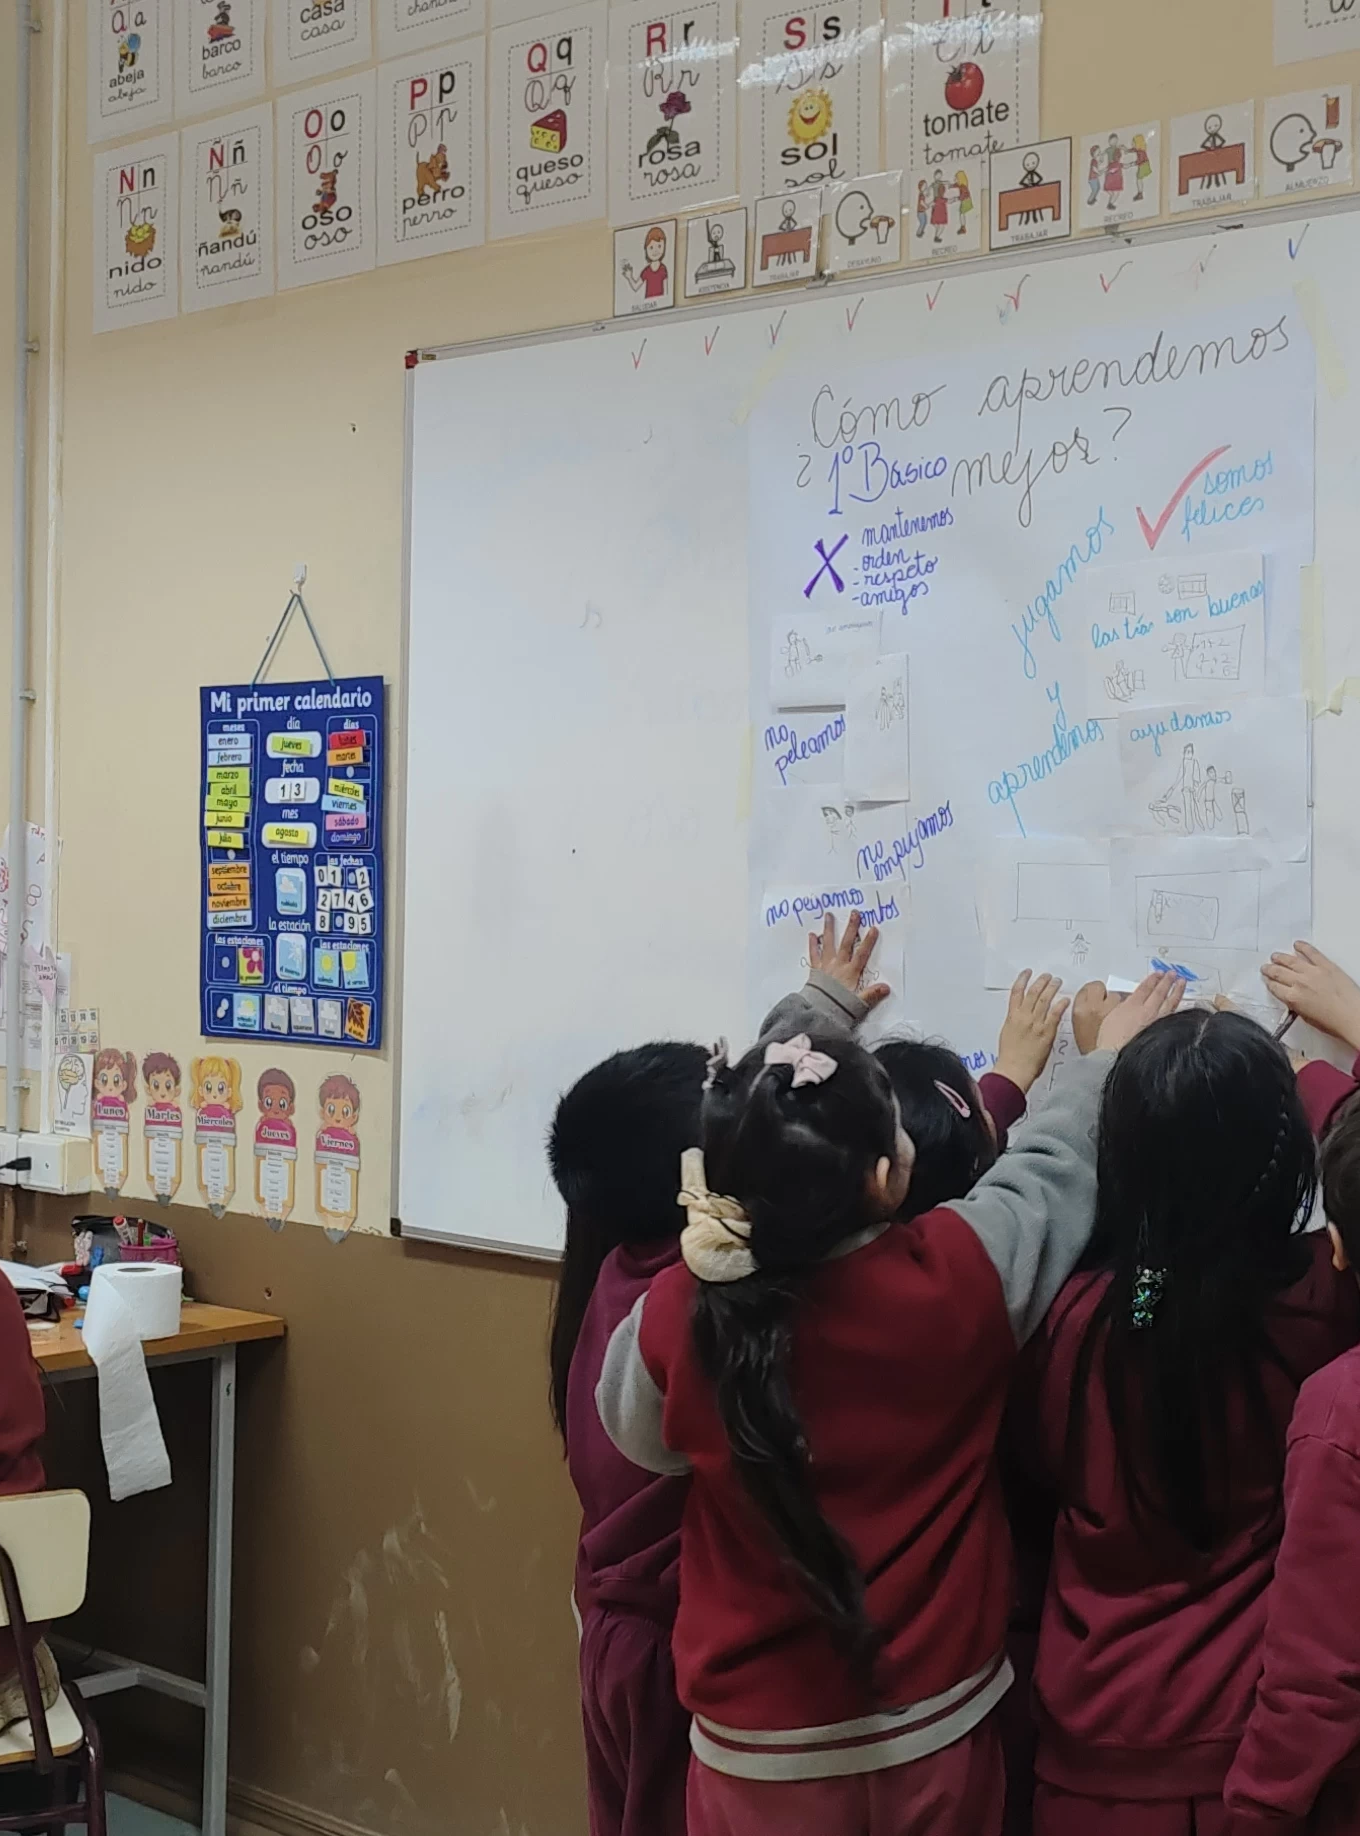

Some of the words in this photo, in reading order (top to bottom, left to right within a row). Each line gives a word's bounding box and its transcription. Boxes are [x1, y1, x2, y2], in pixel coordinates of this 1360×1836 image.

[300, 0, 345, 24] casa
[301, 19, 346, 41] casa
[646, 22, 667, 57] R
[783, 17, 806, 50] S
[823, 16, 840, 41] s
[202, 39, 241, 60] barco
[527, 42, 547, 73] Q
[556, 36, 572, 66] q
[109, 69, 145, 89] abeja
[202, 61, 242, 80] barco
[107, 86, 147, 103] abeja
[410, 78, 428, 110] P
[439, 70, 455, 103] p
[304, 109, 323, 138] O
[330, 109, 346, 132] o
[923, 100, 1009, 138] tomate
[209, 138, 225, 170] Ñ
[233, 139, 245, 165] ñ
[638, 140, 701, 168] rosa
[780, 133, 838, 166] sol
[923, 131, 1006, 165] tomate
[516, 154, 584, 182] queso
[643, 163, 701, 187] rosa
[784, 158, 845, 188] sol
[119, 166, 135, 194] N
[143, 166, 156, 188] n
[516, 172, 584, 205] queso
[1285, 176, 1330, 192] ALMUERZO
[402, 185, 465, 215] perro
[1191, 193, 1232, 208] TRABAJAR
[301, 206, 353, 230] oso
[403, 207, 457, 238] perro
[1103, 211, 1134, 223] RECREO
[198, 229, 257, 258] ñandú
[303, 227, 353, 250] oso
[1010, 229, 1049, 243] TRABAJAR
[109, 256, 162, 279] nido
[200, 252, 255, 277] ñandú
[113, 277, 157, 299] nido
[977, 315, 1289, 453] aprendemos
[1204, 449, 1274, 496] somos
[862, 506, 954, 547] mantenemos
[1181, 495, 1265, 543] felices
[1011, 505, 1115, 680] jugamos
[1091, 623, 1120, 649] las
[1165, 605, 1199, 624] son
[210, 691, 232, 713] Mi
[237, 692, 291, 719] primer
[294, 687, 372, 711] calendario
[1046, 680, 1067, 731] y
[222, 723, 245, 732] meses
[286, 716, 301, 730] día
[343, 719, 360, 730] días
[218, 737, 239, 746] enero
[280, 737, 302, 751] jueves
[338, 734, 358, 745] lunes
[765, 724, 789, 751] no
[1130, 711, 1232, 757] ayudamos
[217, 753, 242, 764] febrero
[335, 752, 356, 761] martes
[775, 714, 847, 786] peleamos
[216, 771, 239, 780] marzo
[281, 759, 304, 777] fecha
[988, 719, 1104, 839] aprendemos
[221, 784, 237, 796] abril
[334, 783, 360, 797] miércoles
[216, 798, 238, 809] mayo
[282, 808, 299, 819] mes
[332, 801, 358, 811] viernes
[215, 814, 233, 825] junio
[334, 815, 359, 826] sábado
[219, 832, 232, 843] julio
[275, 827, 299, 839] agosto
[331, 832, 361, 844] domingo
[874, 800, 954, 882] empujamos
[272, 852, 280, 864] el
[281, 851, 309, 868] tiempo
[328, 855, 339, 865] las
[340, 855, 364, 867] fechas
[857, 840, 884, 880] no
[211, 864, 247, 876] septiembre
[216, 881, 242, 891] octubre
[211, 897, 247, 908] noviembre
[212, 913, 248, 924] diciembre
[766, 899, 790, 927] no
[269, 917, 277, 931] la
[278, 917, 311, 933] estación
[215, 934, 224, 944] las
[225, 935, 264, 946] estaciones
[332, 942, 369, 952] estaciones
[274, 984, 281, 993] el
[281, 984, 307, 996] tiempo
[97, 1105, 124, 1116] Lunes
[147, 1109, 181, 1121] Martes
[262, 1126, 290, 1139] Jueves
[321, 1135, 354, 1149] Viernes
